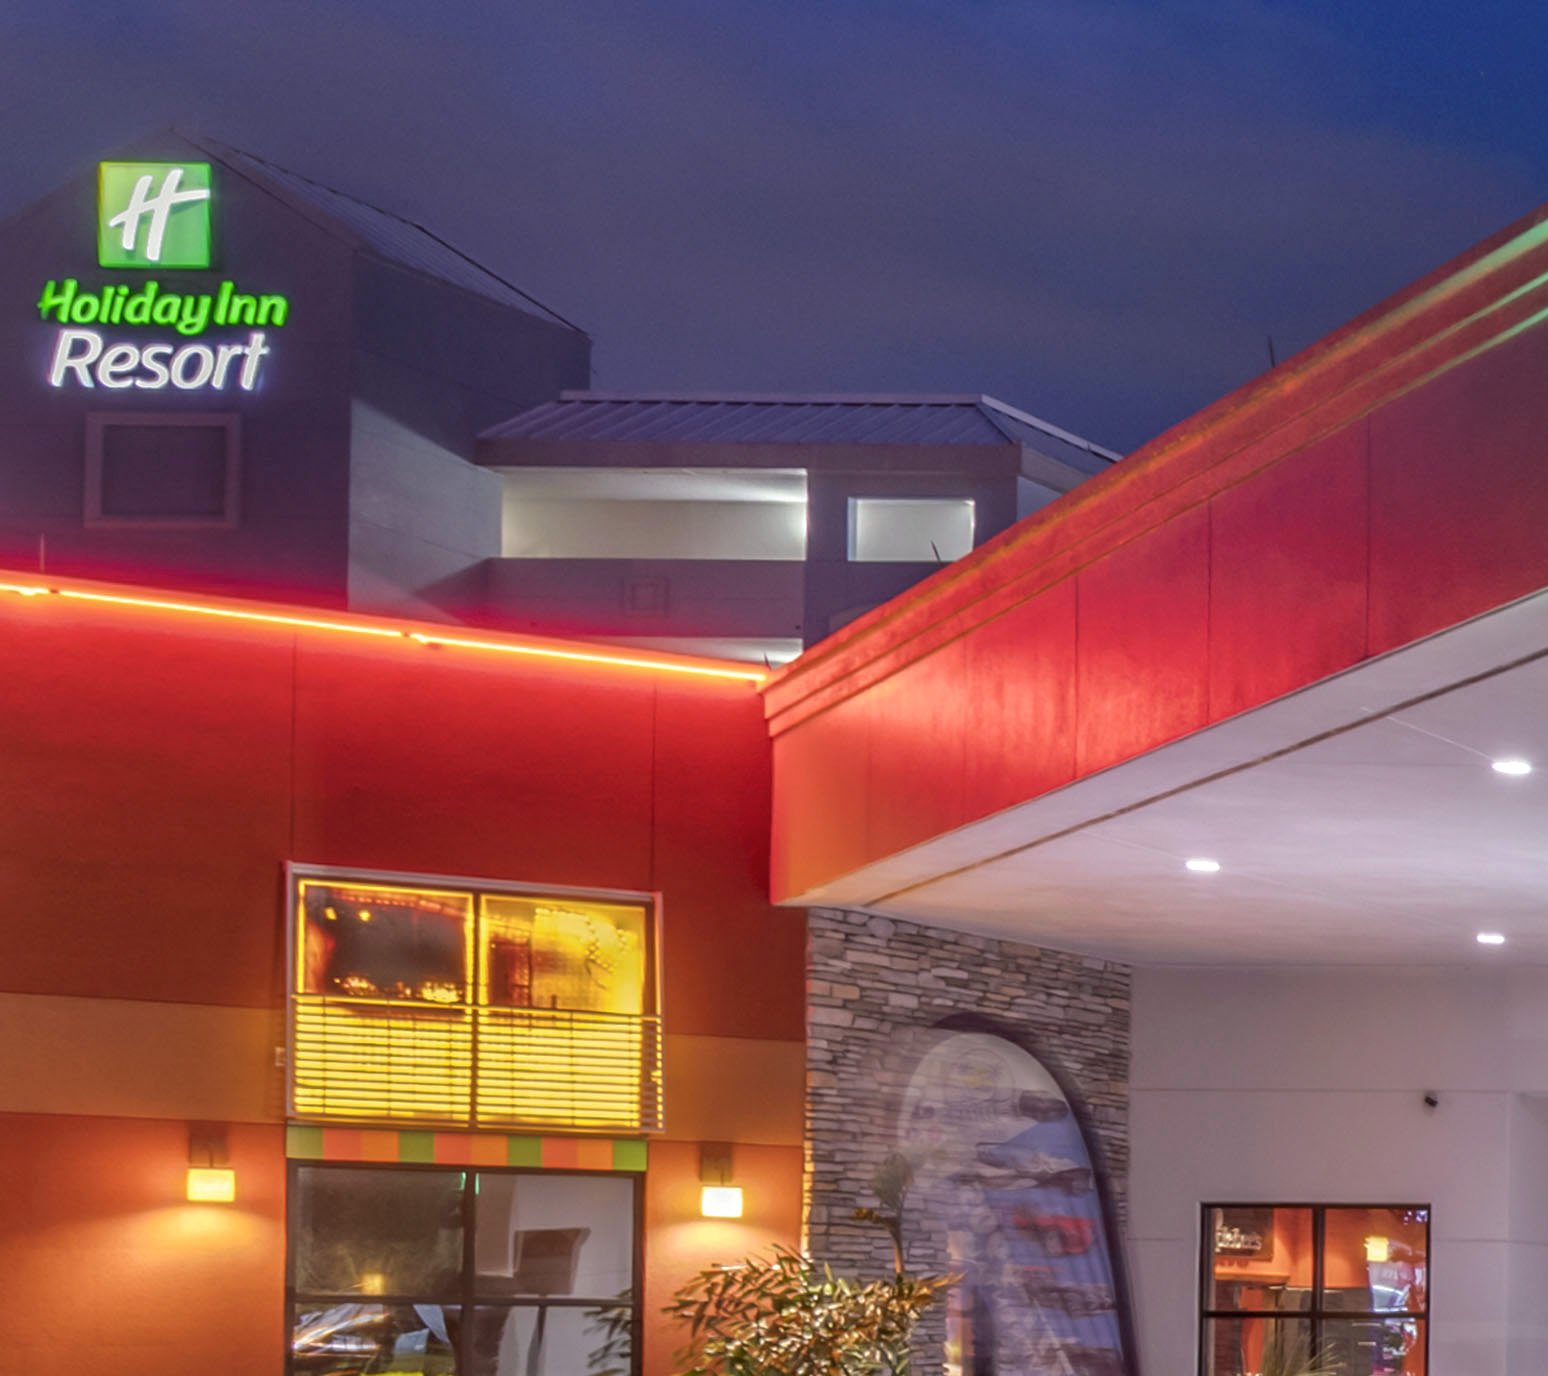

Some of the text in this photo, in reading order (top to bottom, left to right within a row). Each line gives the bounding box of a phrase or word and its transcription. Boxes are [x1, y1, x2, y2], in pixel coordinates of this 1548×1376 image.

[37, 278, 289, 335] Holiday Inn
[50, 327, 270, 391] Resort
